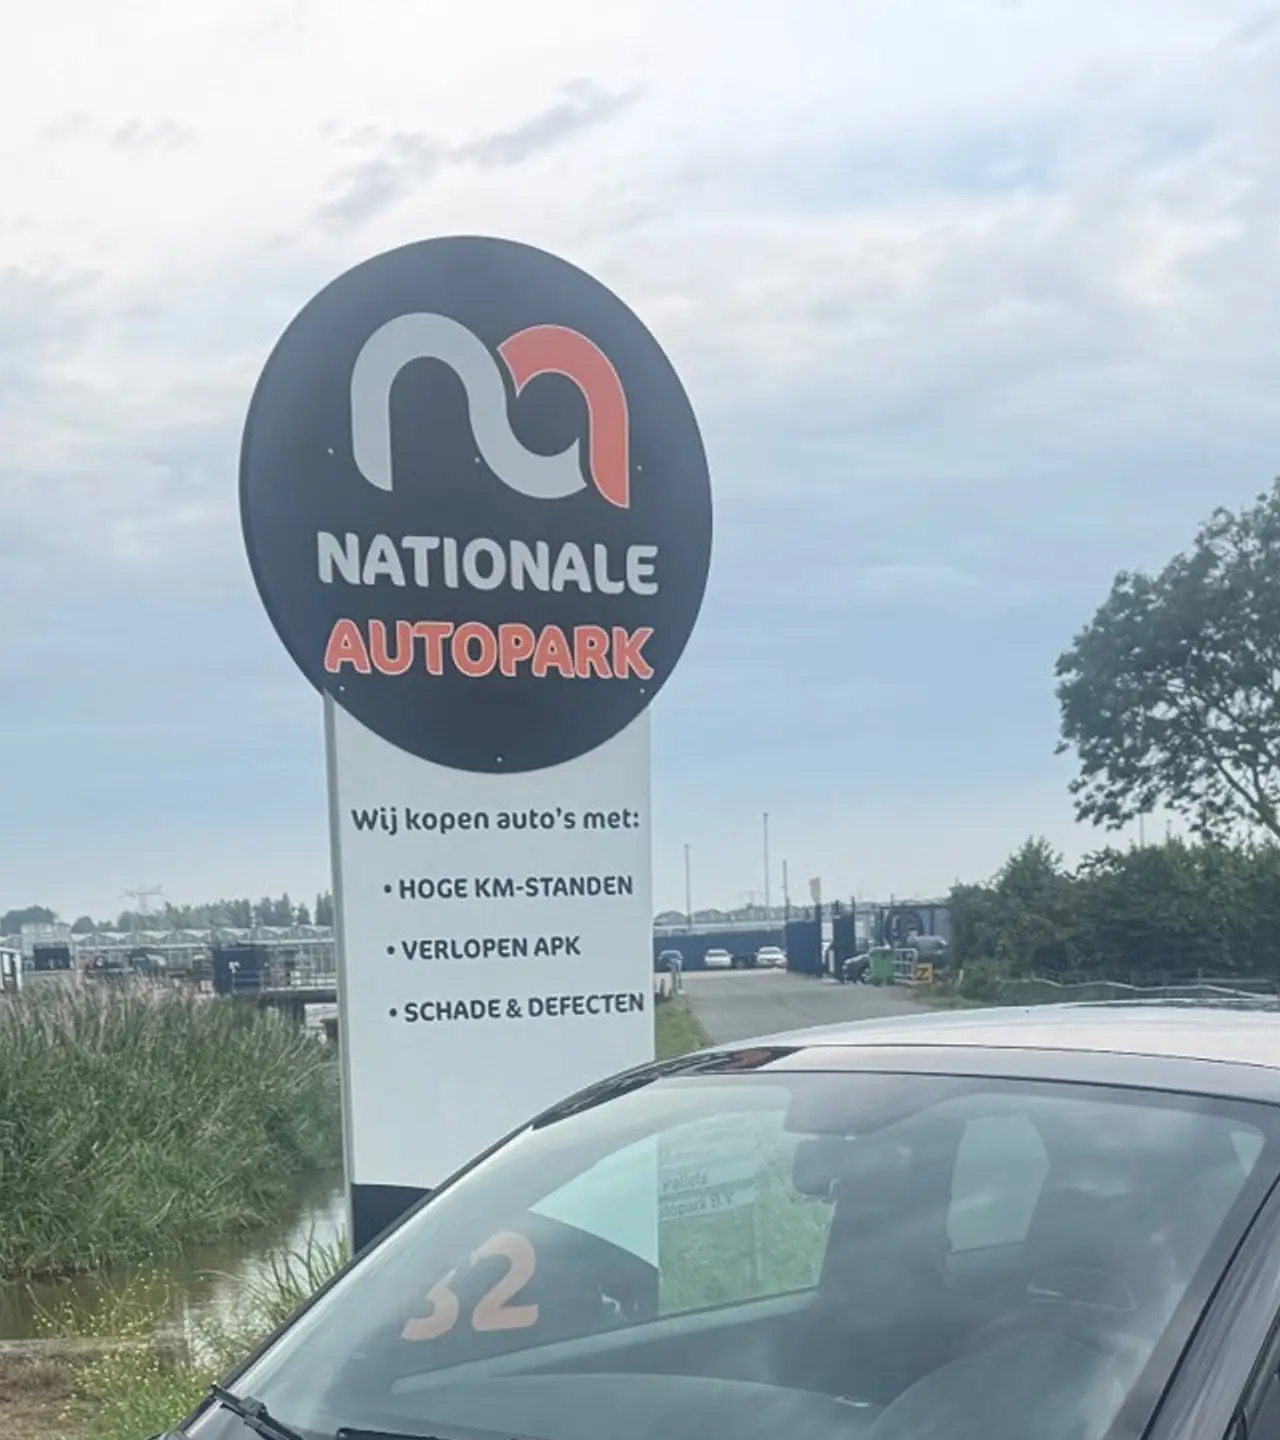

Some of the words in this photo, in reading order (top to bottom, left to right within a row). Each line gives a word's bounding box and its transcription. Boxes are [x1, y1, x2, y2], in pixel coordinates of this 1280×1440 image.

[317, 531, 659, 596] NATIONALE
[324, 618, 655, 680] AUTOPARK
[351, 806, 399, 836] Wij
[405, 807, 490, 835] kopen
[496, 807, 577, 830] auto's
[583, 810, 640, 830] met:
[399, 877, 468, 899] HOGE
[475, 875, 634, 899] KM-STANDEN
[401, 937, 528, 960] VERLOPEN
[534, 935, 582, 957] APK
[403, 998, 502, 1023] SCHADE
[506, 998, 523, 1018] &
[527, 992, 645, 1018] DEFECTEN
